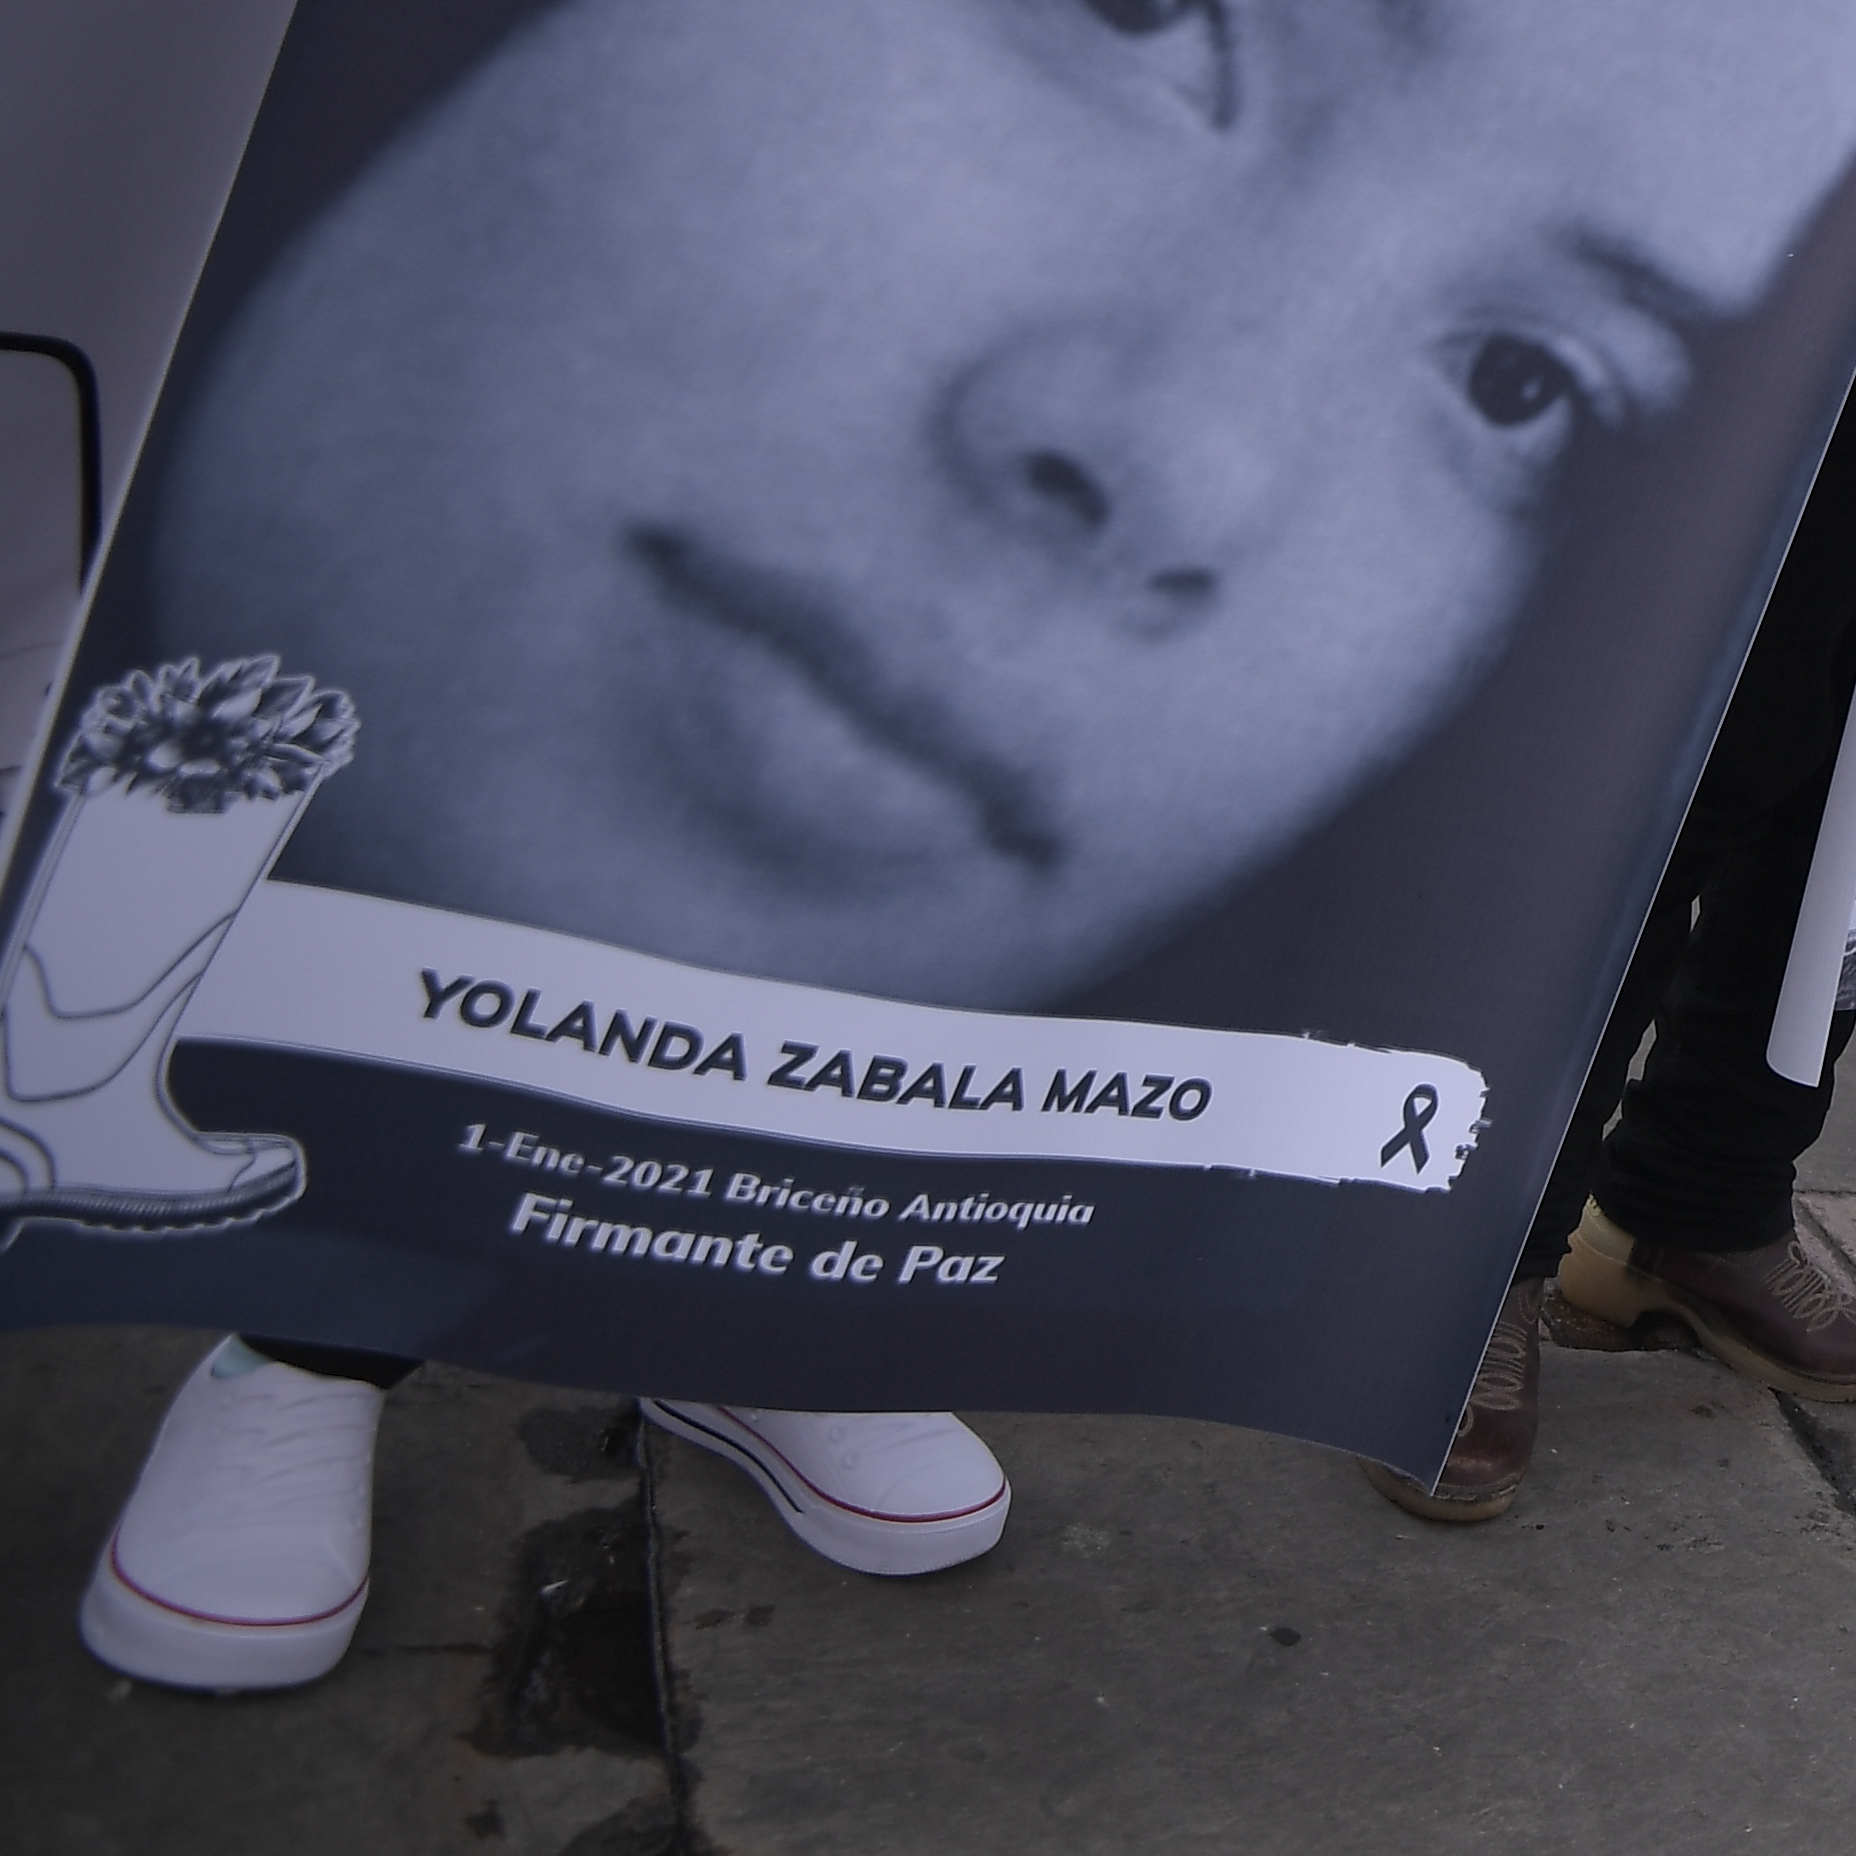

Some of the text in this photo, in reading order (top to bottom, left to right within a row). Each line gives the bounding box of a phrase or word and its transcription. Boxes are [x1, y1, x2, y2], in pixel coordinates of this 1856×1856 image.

[420, 966, 1214, 1122] YOLANDA ZABALA MAZO
[458, 1122, 1095, 1229] 1-Ene-2021 Briceño Antioquia
[510, 1191, 1006, 1285] Firmante de Paz
